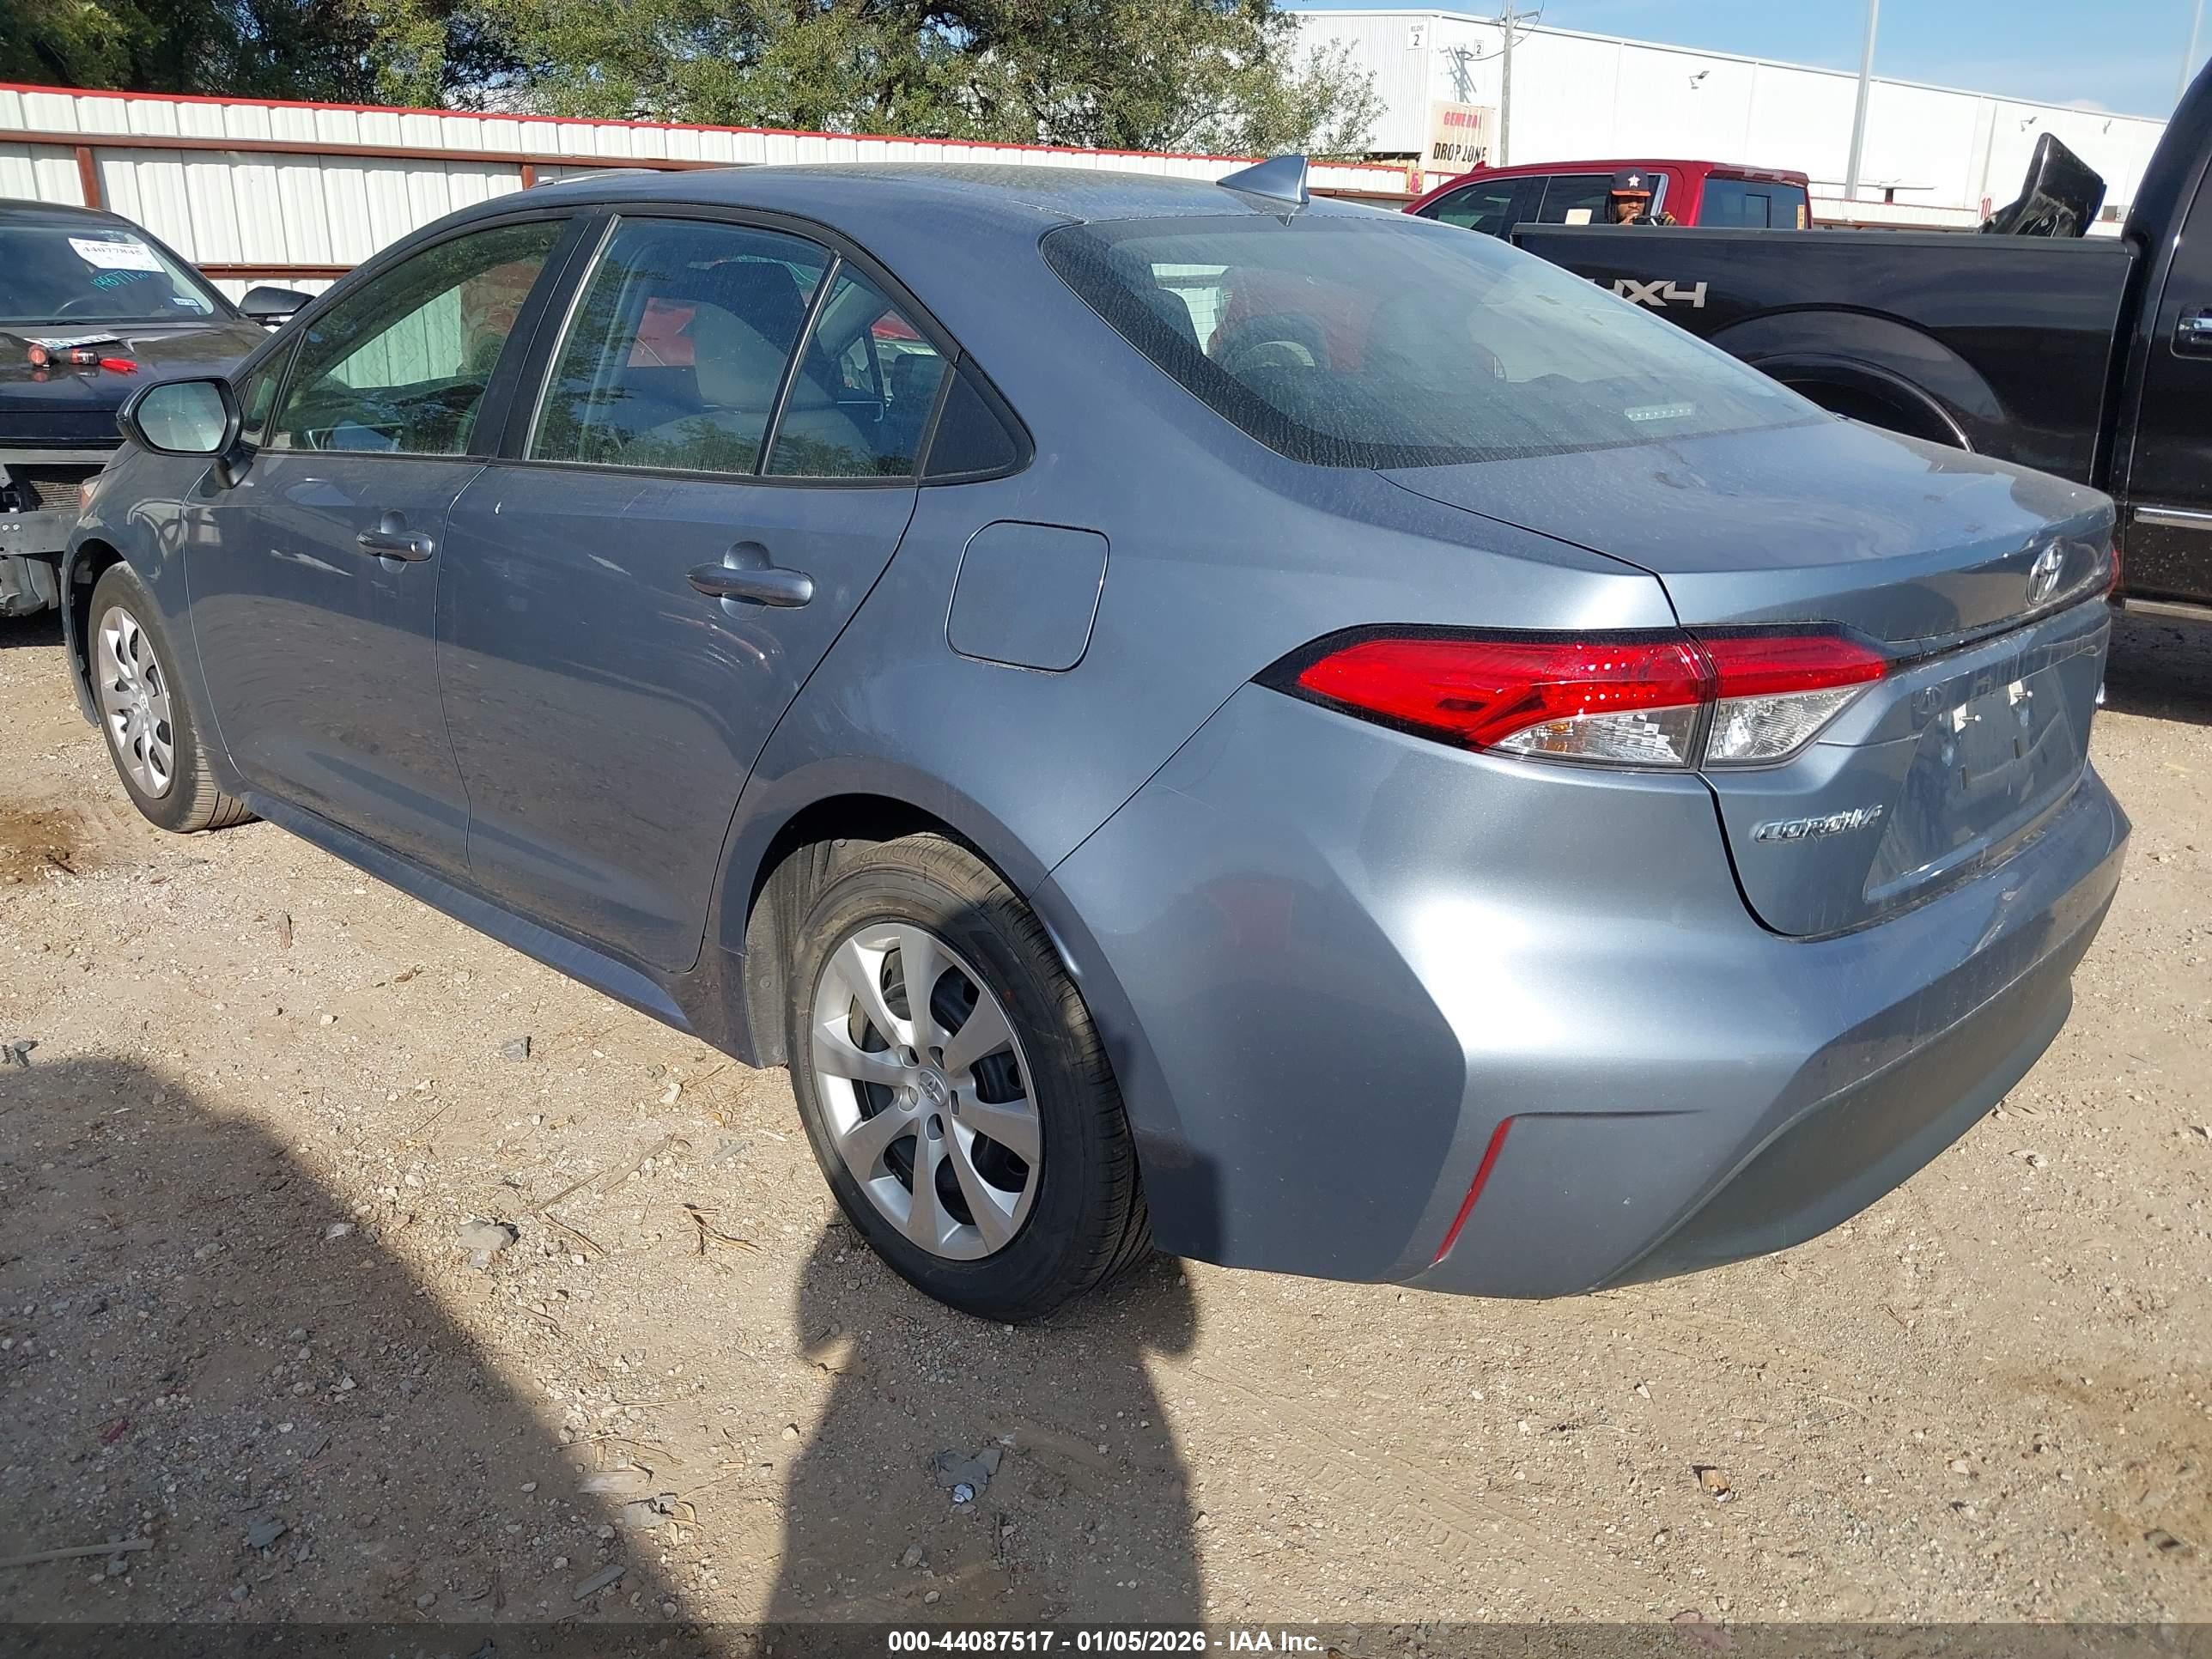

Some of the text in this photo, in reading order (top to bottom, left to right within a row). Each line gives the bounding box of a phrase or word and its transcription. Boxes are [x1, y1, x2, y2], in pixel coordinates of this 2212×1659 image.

[1413, 33, 1419, 46] 2
[1476, 45, 1481, 54] 2
[1432, 143, 1462, 161] DROP
[1979, 197, 1992, 221] 10
